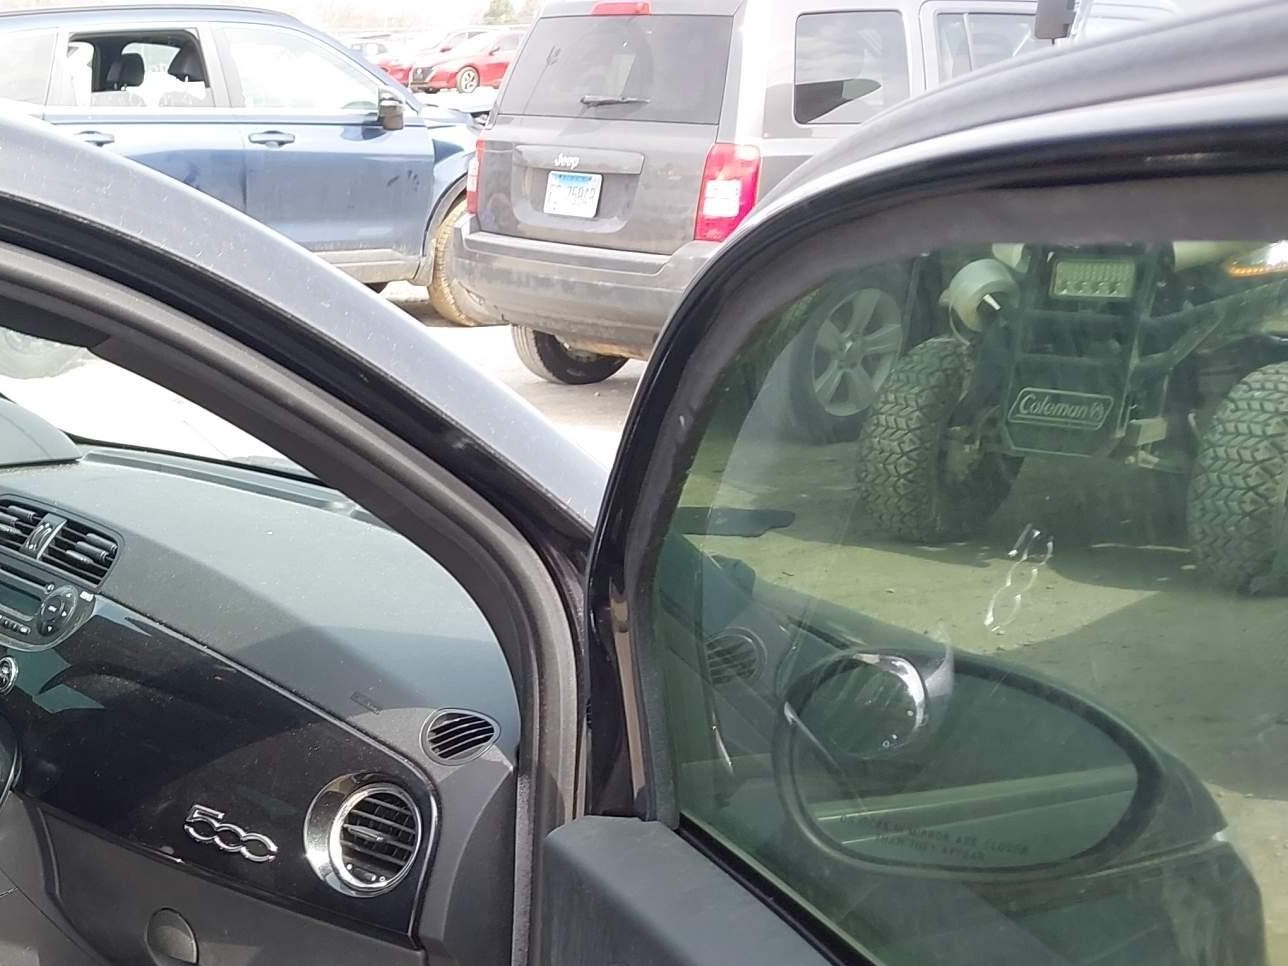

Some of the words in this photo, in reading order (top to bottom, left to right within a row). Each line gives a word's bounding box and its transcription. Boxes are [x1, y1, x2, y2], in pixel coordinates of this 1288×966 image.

[554, 152, 580, 170] Jeep
[1019, 393, 1089, 419] Coleman
[184, 804, 278, 862] 500
